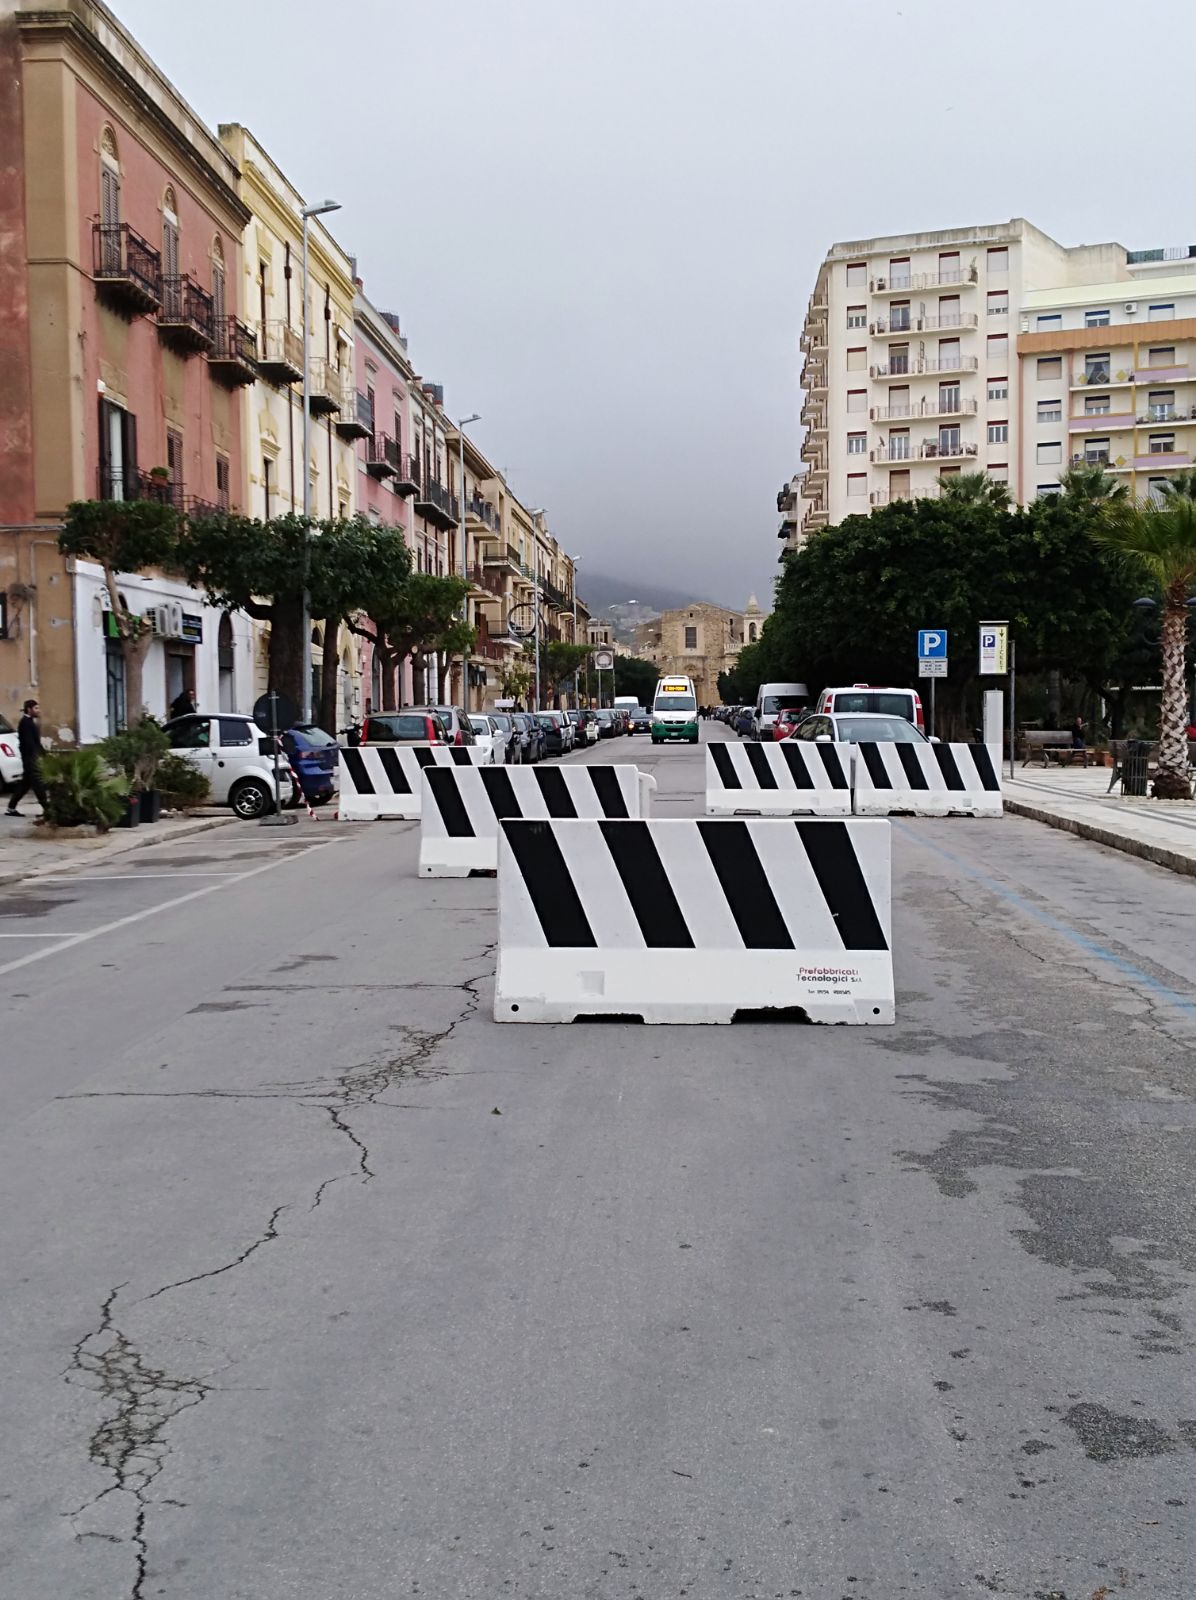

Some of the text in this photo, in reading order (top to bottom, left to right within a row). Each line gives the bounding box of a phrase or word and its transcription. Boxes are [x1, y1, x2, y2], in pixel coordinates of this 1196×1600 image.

[924, 633, 941, 656] P
[985, 635, 994, 647] P
[799, 967, 859, 976] Prefabbricati
[796, 973, 848, 983] Tecnologici
